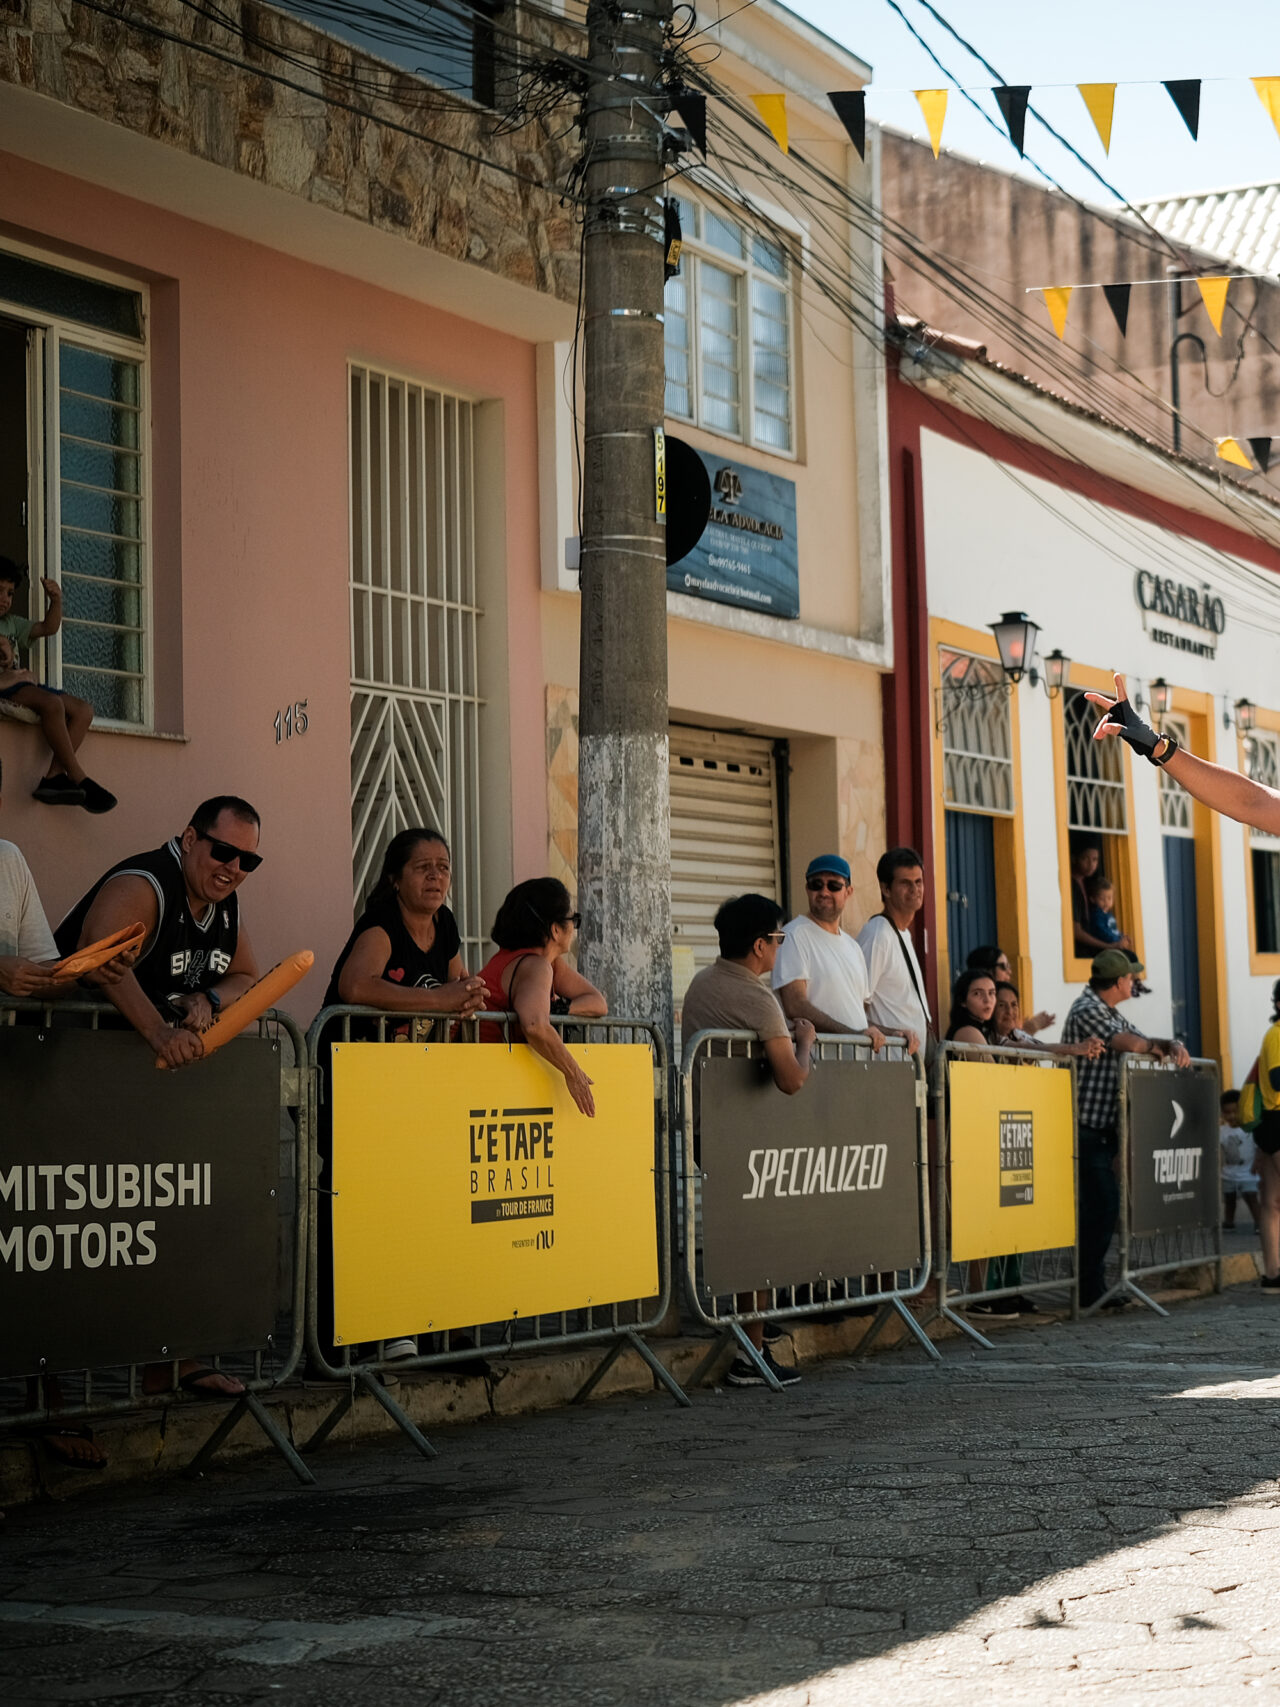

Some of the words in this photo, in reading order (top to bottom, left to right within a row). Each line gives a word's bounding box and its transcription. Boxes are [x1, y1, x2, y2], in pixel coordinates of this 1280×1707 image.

[656, 434, 665, 512] 5197
[732, 512, 784, 540] ADVOCACIA
[1136, 569, 1225, 635] CASARÃO
[1151, 627, 1216, 661] RESTAURANTE
[273, 697, 309, 745] 115
[201, 1016, 221, 1034] BIKE
[470, 1165, 554, 1194] BRASIL
[742, 1143, 888, 1200] SPECIALIZED
[1000, 1150, 1033, 1168] BRASIL
[0, 1162, 212, 1211] MITSUBISHI
[501, 1202, 519, 1217] TOUR
[519, 1201, 528, 1215] DE
[527, 1198, 552, 1214] FRANCE
[0, 1220, 157, 1273] MOTORS
